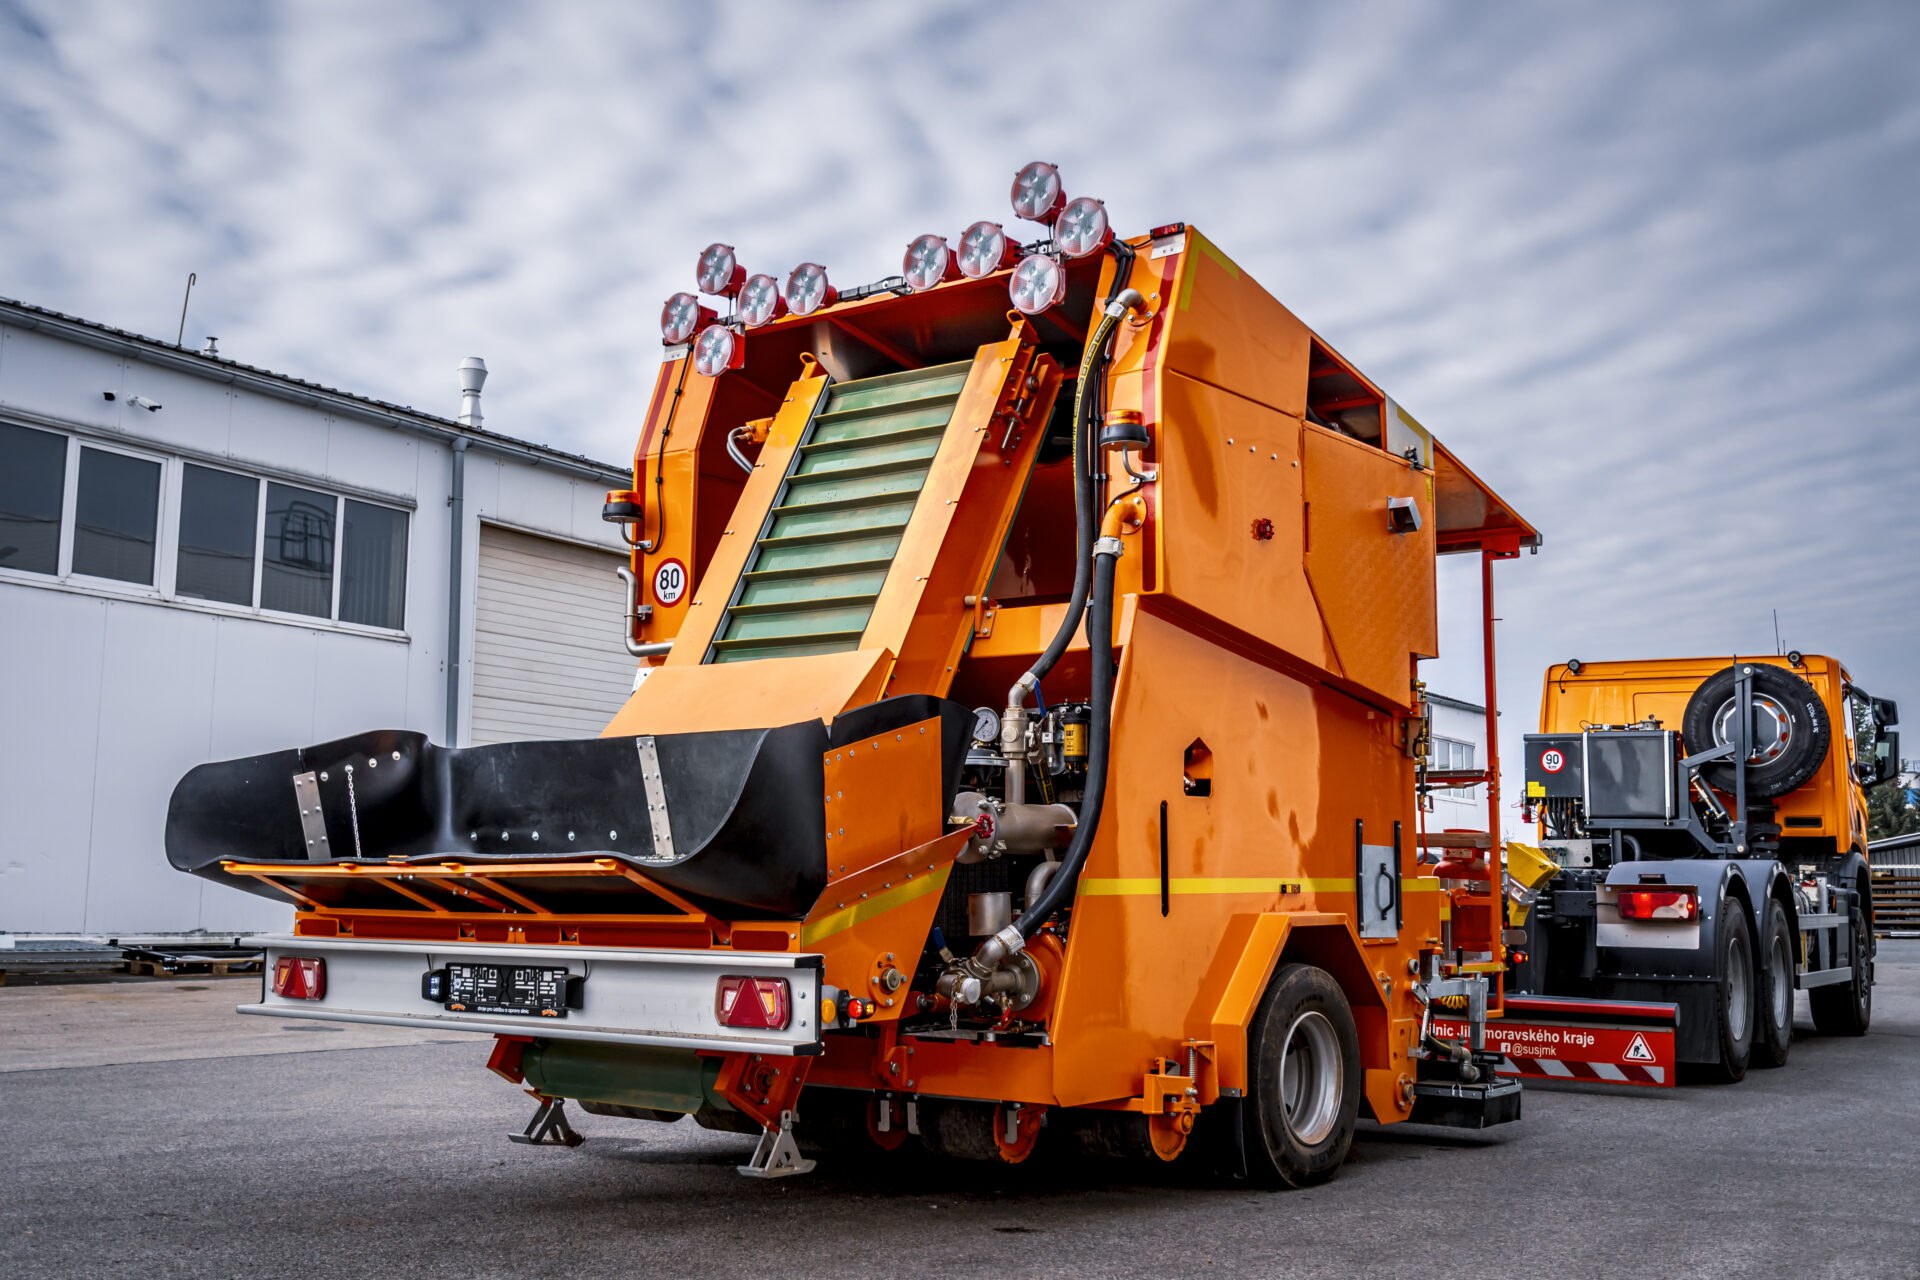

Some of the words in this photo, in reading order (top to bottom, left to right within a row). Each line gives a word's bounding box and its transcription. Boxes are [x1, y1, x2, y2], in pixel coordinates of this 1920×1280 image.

[660, 568, 680, 590] 80
[663, 591, 676, 600] km
[1545, 753, 1560, 765] 90
[1425, 1023, 1454, 1037] ilnic
[1457, 1025, 1560, 1042] Jimoravského
[1563, 1030, 1595, 1048] kraje
[1512, 1042, 1557, 1058] @susjmk
